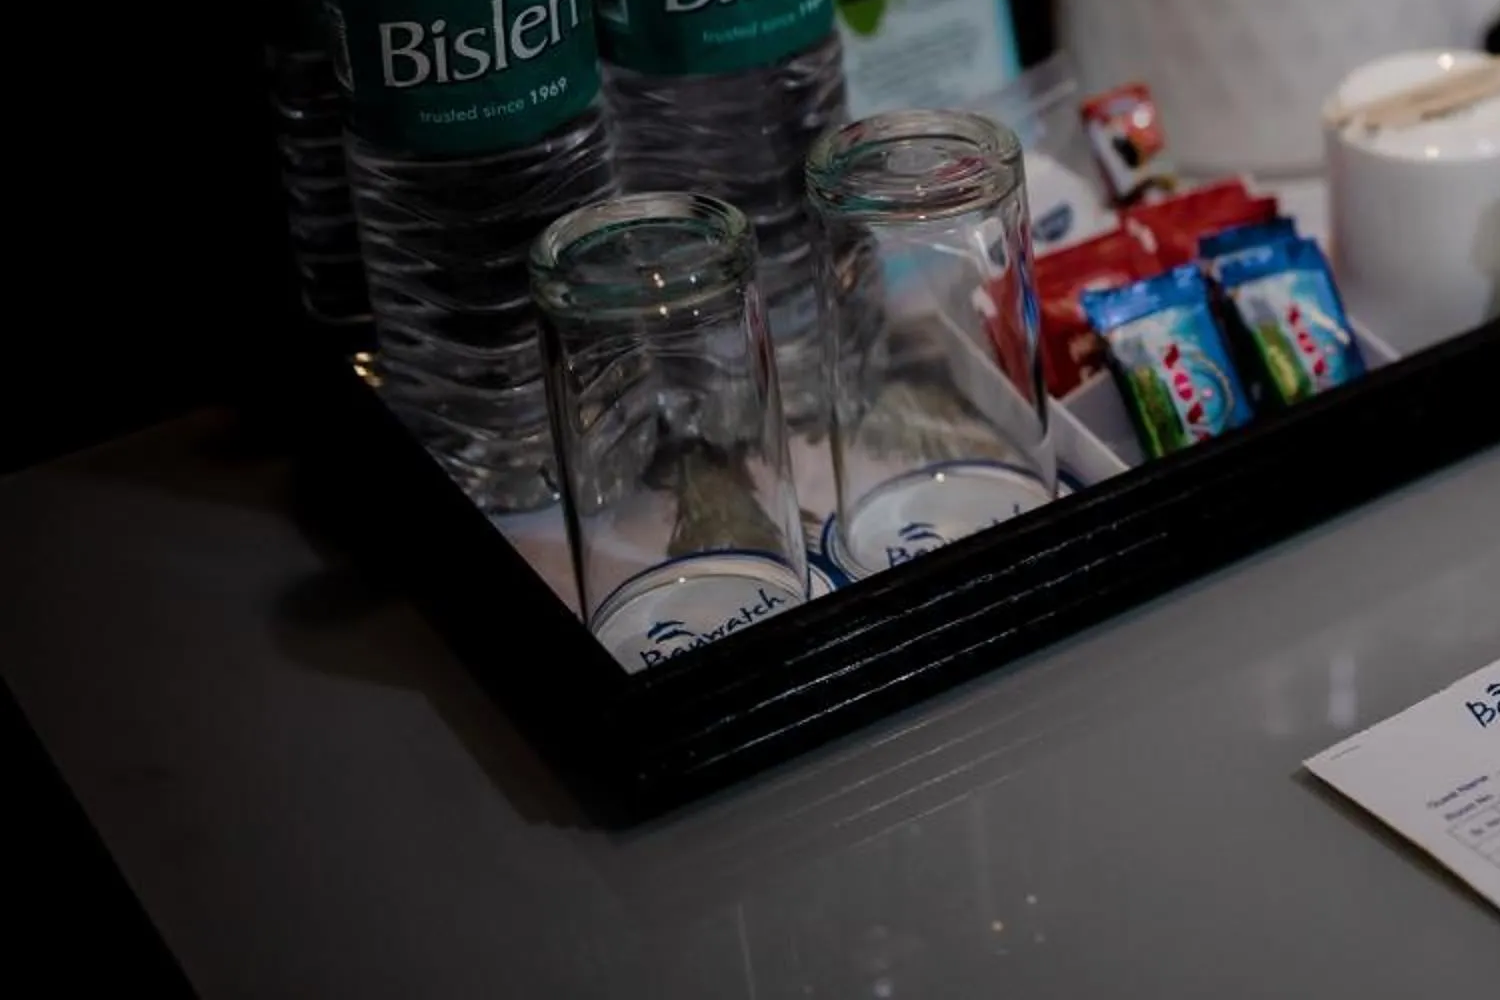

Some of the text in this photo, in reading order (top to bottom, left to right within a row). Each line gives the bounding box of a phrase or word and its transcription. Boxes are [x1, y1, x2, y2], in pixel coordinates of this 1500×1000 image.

[420, 76, 568, 124] trusted since 1969
